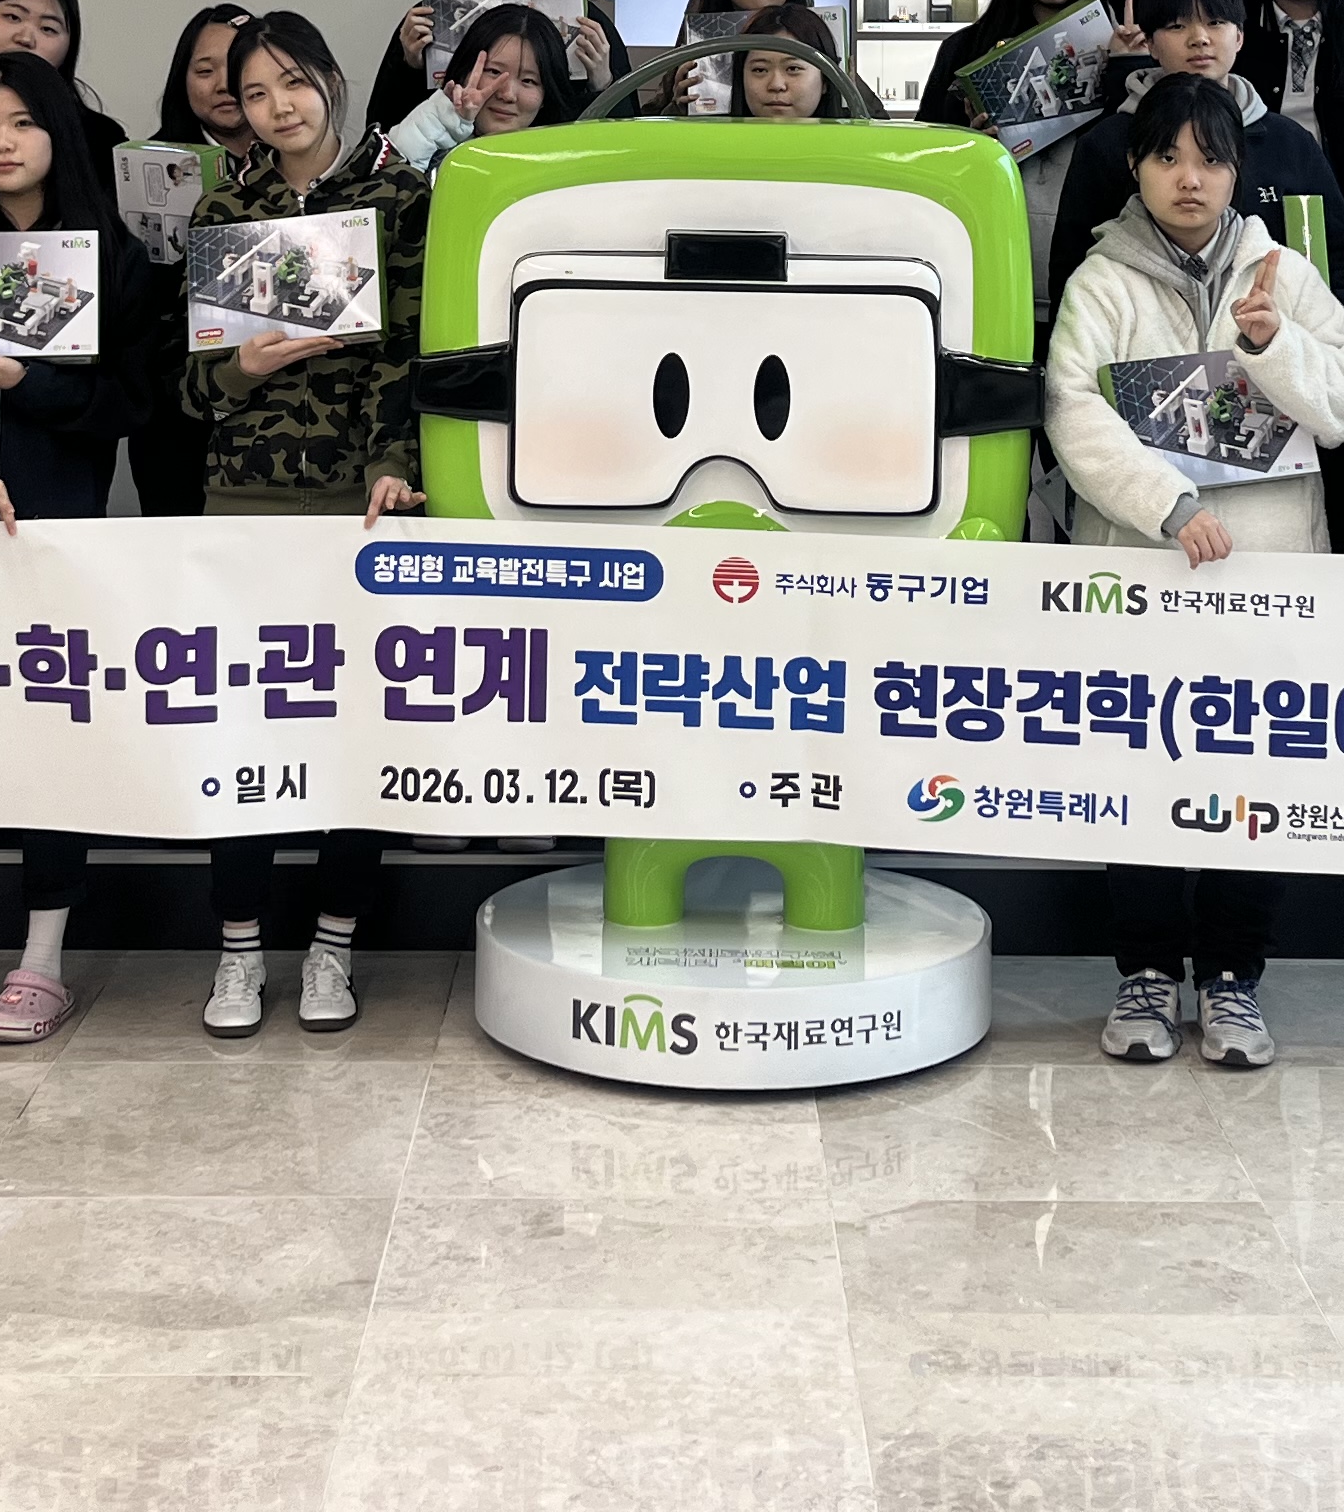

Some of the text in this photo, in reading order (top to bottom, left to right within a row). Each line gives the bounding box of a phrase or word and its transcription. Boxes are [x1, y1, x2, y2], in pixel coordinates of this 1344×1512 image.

[342, 216, 369, 228] KIMS
[62, 237, 91, 249] KIMS
[373, 552, 646, 590] 창원형 교육발전특구 사업
[775, 572, 989, 605] 주식회사 동구기업
[1042, 572, 1316, 619] KIMS 한국재료연구원
[374, 624, 549, 724] 연계
[574, 650, 847, 734] 전략산업
[380, 765, 472, 805] 2026.
[544, 768, 589, 806] 12.
[599, 768, 656, 809] (목)
[973, 784, 1128, 826] 창원특례시
[1286, 831, 1328, 842] Changwon
[571, 994, 903, 1056] KIMS 한국재료연구원
